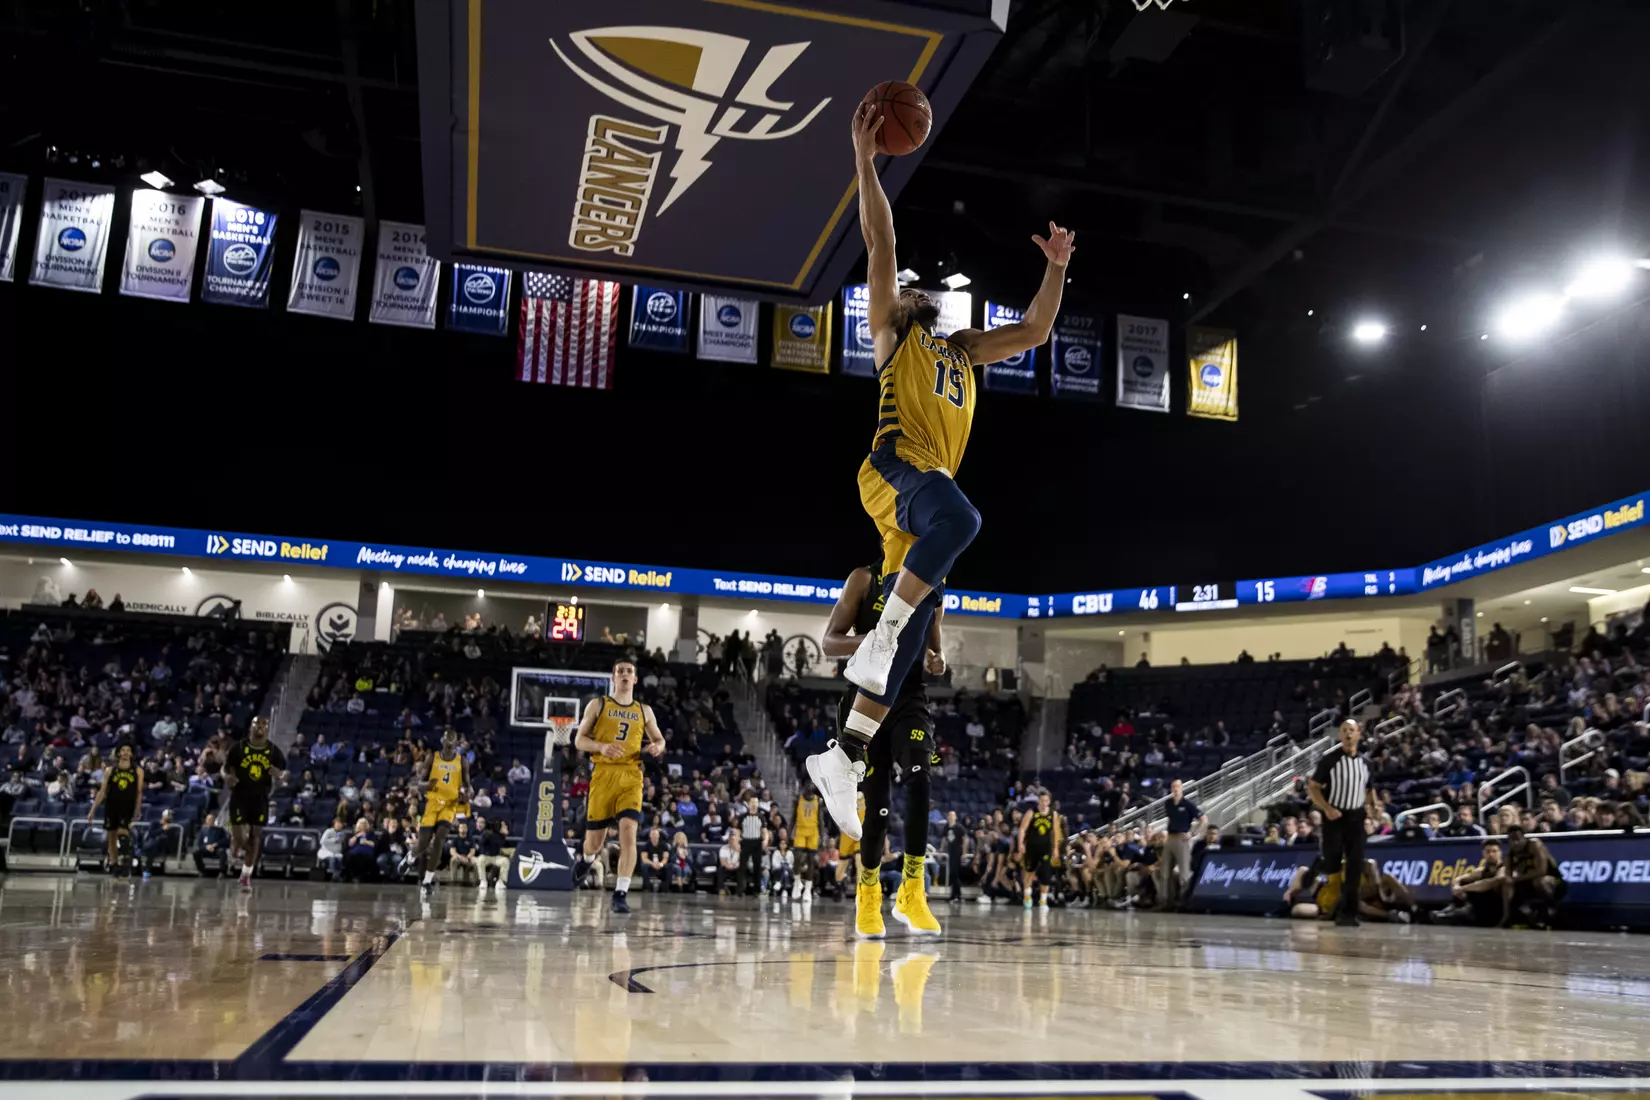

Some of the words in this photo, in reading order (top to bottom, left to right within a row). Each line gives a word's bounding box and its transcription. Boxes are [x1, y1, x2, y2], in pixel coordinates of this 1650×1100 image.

[568, 114, 669, 257] LANCERS
[150, 203, 186, 216] 016
[314, 220, 350, 235] 2015
[315, 235, 344, 245] MEN'S
[46, 255, 84, 266] DIVISION
[136, 265, 175, 276] DIVISION
[298, 282, 342, 295] DIVISION
[300, 293, 332, 304] SWEET
[336, 297, 345, 305] 16
[384, 292, 420, 303] DIVISION
[1063, 315, 1094, 328] 2017
[725, 332, 754, 341] REGION
[1128, 324, 1158, 336] 2017
[704, 338, 752, 348] CHAMPIONS
[844, 349, 875, 359] CHAMP
[933, 358, 966, 410] 15
[1567, 514, 1603, 541] SEND
[1604, 499, 1644, 529] Relief
[0, 524, 18, 537] ext
[21, 525, 61, 539] SEND
[64, 528, 114, 543] RELIEF
[116, 532, 130, 545] to
[132, 533, 175, 548] 888111
[231, 538, 277, 557] SEND
[280, 542, 329, 561] Relief
[357, 546, 405, 568] Meeting
[443, 553, 496, 576] changing
[499, 558, 528, 575] lives
[584, 567, 625, 584] SEND
[628, 570, 672, 587] Relief
[713, 578, 737, 591] Text
[738, 580, 771, 594] SEND
[773, 582, 815, 597] RELIEF
[816, 586, 828, 598] to
[1255, 581, 1275, 603] 15
[125, 602, 187, 613] ADEMICALLY
[961, 596, 1002, 613] Relief
[1072, 593, 1113, 614] CBU
[1139, 589, 1158, 610] 46
[255, 611, 309, 621] BIBLICALLY
[556, 604, 583, 620] 2:31
[552, 617, 578, 639] 29
[607, 708, 639, 721] LANCERS
[615, 721, 630, 741] 3
[441, 771, 450, 785] 4
[535, 781, 555, 841] CBU
[1382, 860, 1428, 886] SEND
[1558, 860, 1612, 883] SEND
[1613, 860, 1650, 883] REL
